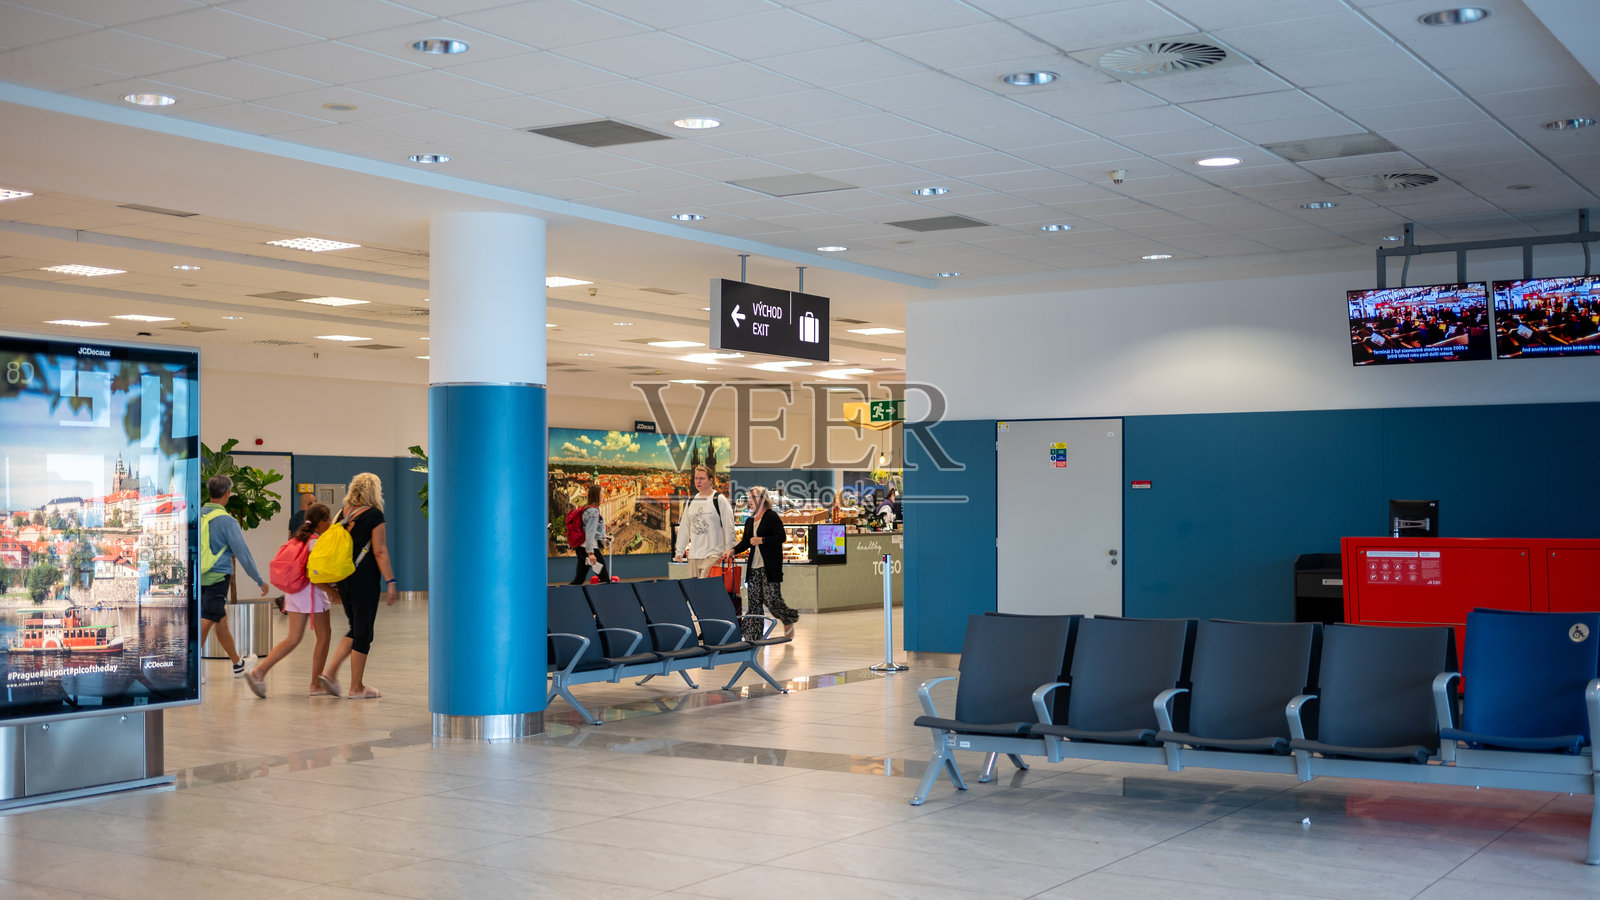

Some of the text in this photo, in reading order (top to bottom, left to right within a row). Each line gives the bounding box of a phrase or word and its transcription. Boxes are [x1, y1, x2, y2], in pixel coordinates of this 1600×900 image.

[752, 301, 783, 319] VÝCHOD
[752, 322, 770, 336] EXIT
[78, 347, 111, 357] JCDecaux
[856, 540, 882, 555] healthy
[144, 661, 174, 669] JCDecaux
